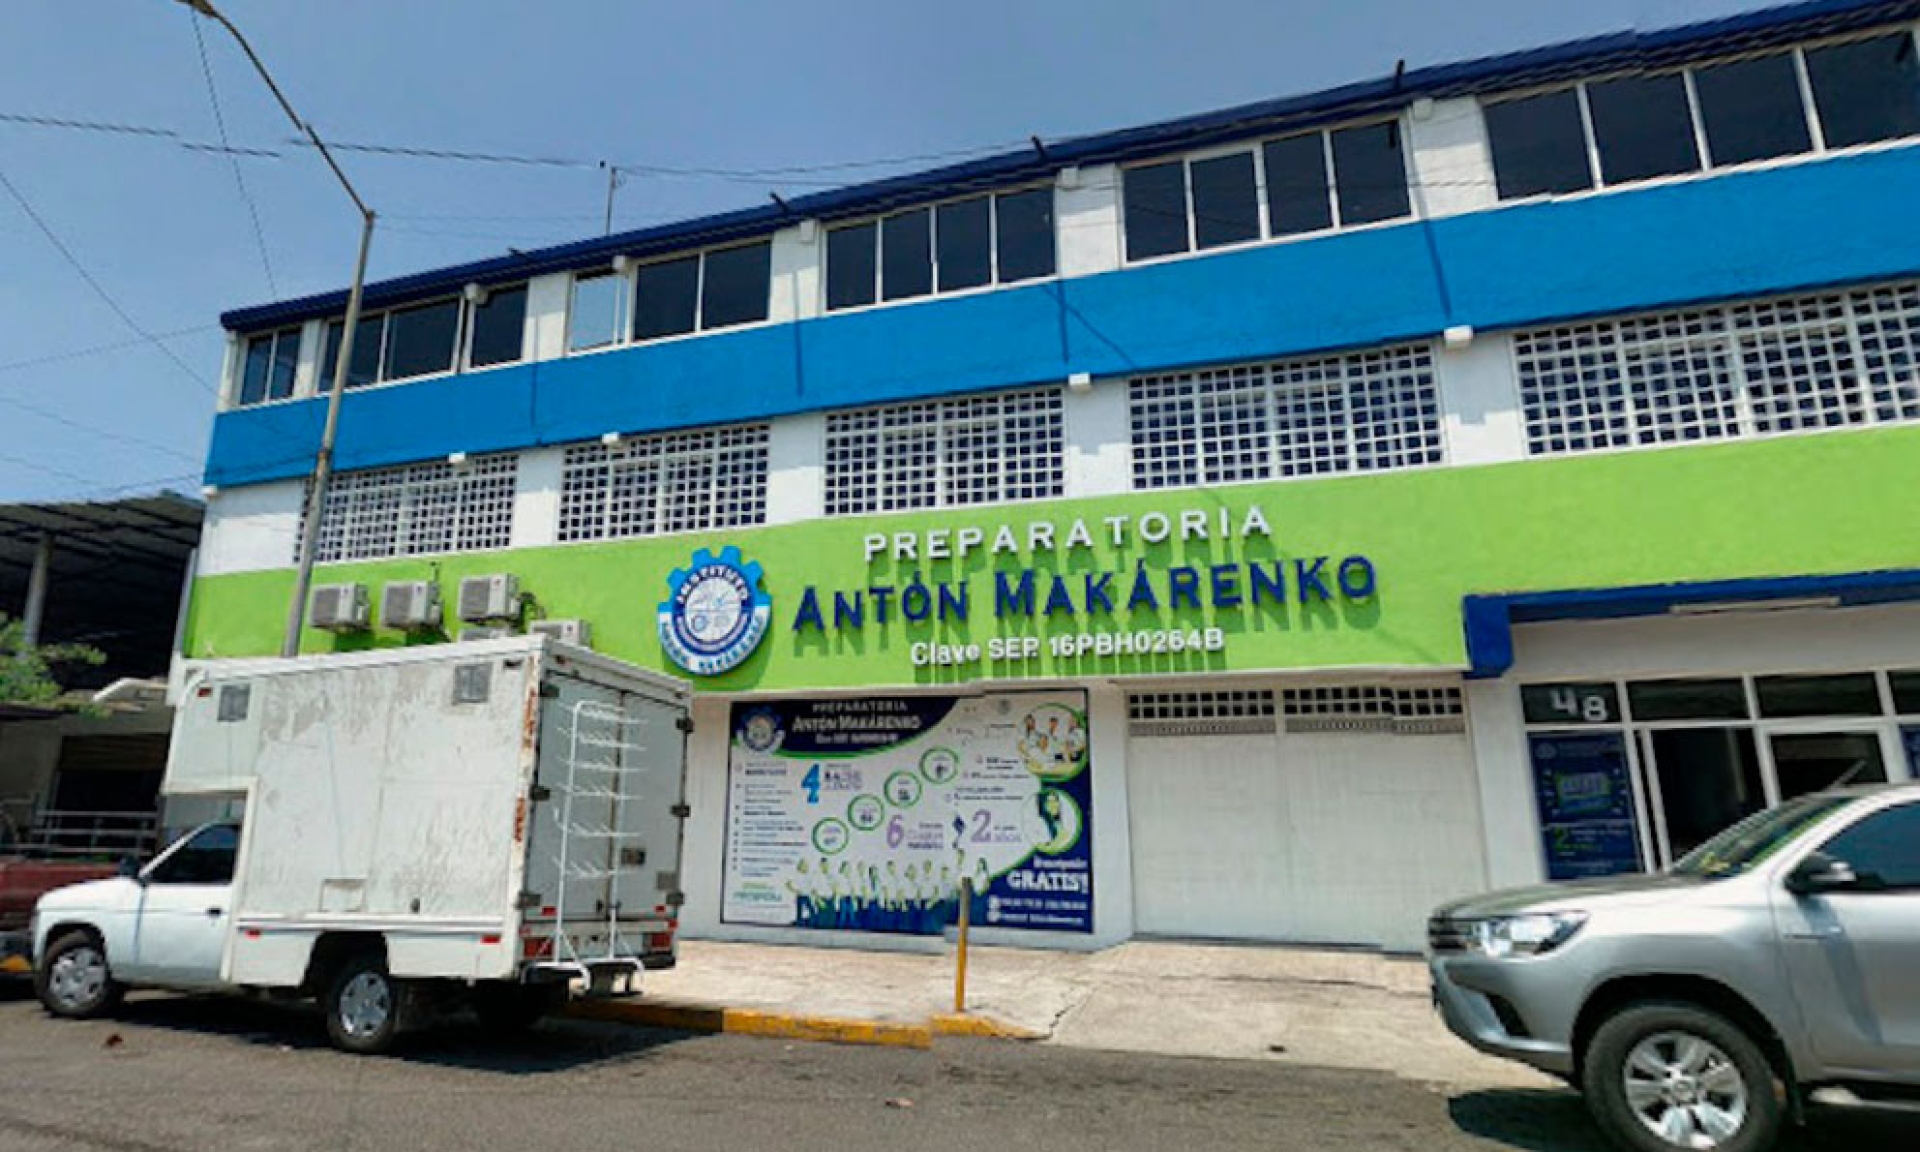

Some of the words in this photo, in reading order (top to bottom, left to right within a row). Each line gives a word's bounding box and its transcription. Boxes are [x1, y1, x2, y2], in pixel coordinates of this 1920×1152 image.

[863, 505, 1271, 562] PREPARATORIA
[792, 571, 970, 631] ANTÓN
[994, 555, 1377, 618] MAKÁRENKO
[910, 641, 981, 666] Clave
[1048, 627, 1224, 657] 16PBH0264B
[1549, 686, 1608, 721] 48
[801, 763, 820, 804] 4
[887, 815, 904, 848] 6
[971, 809, 992, 842] 2
